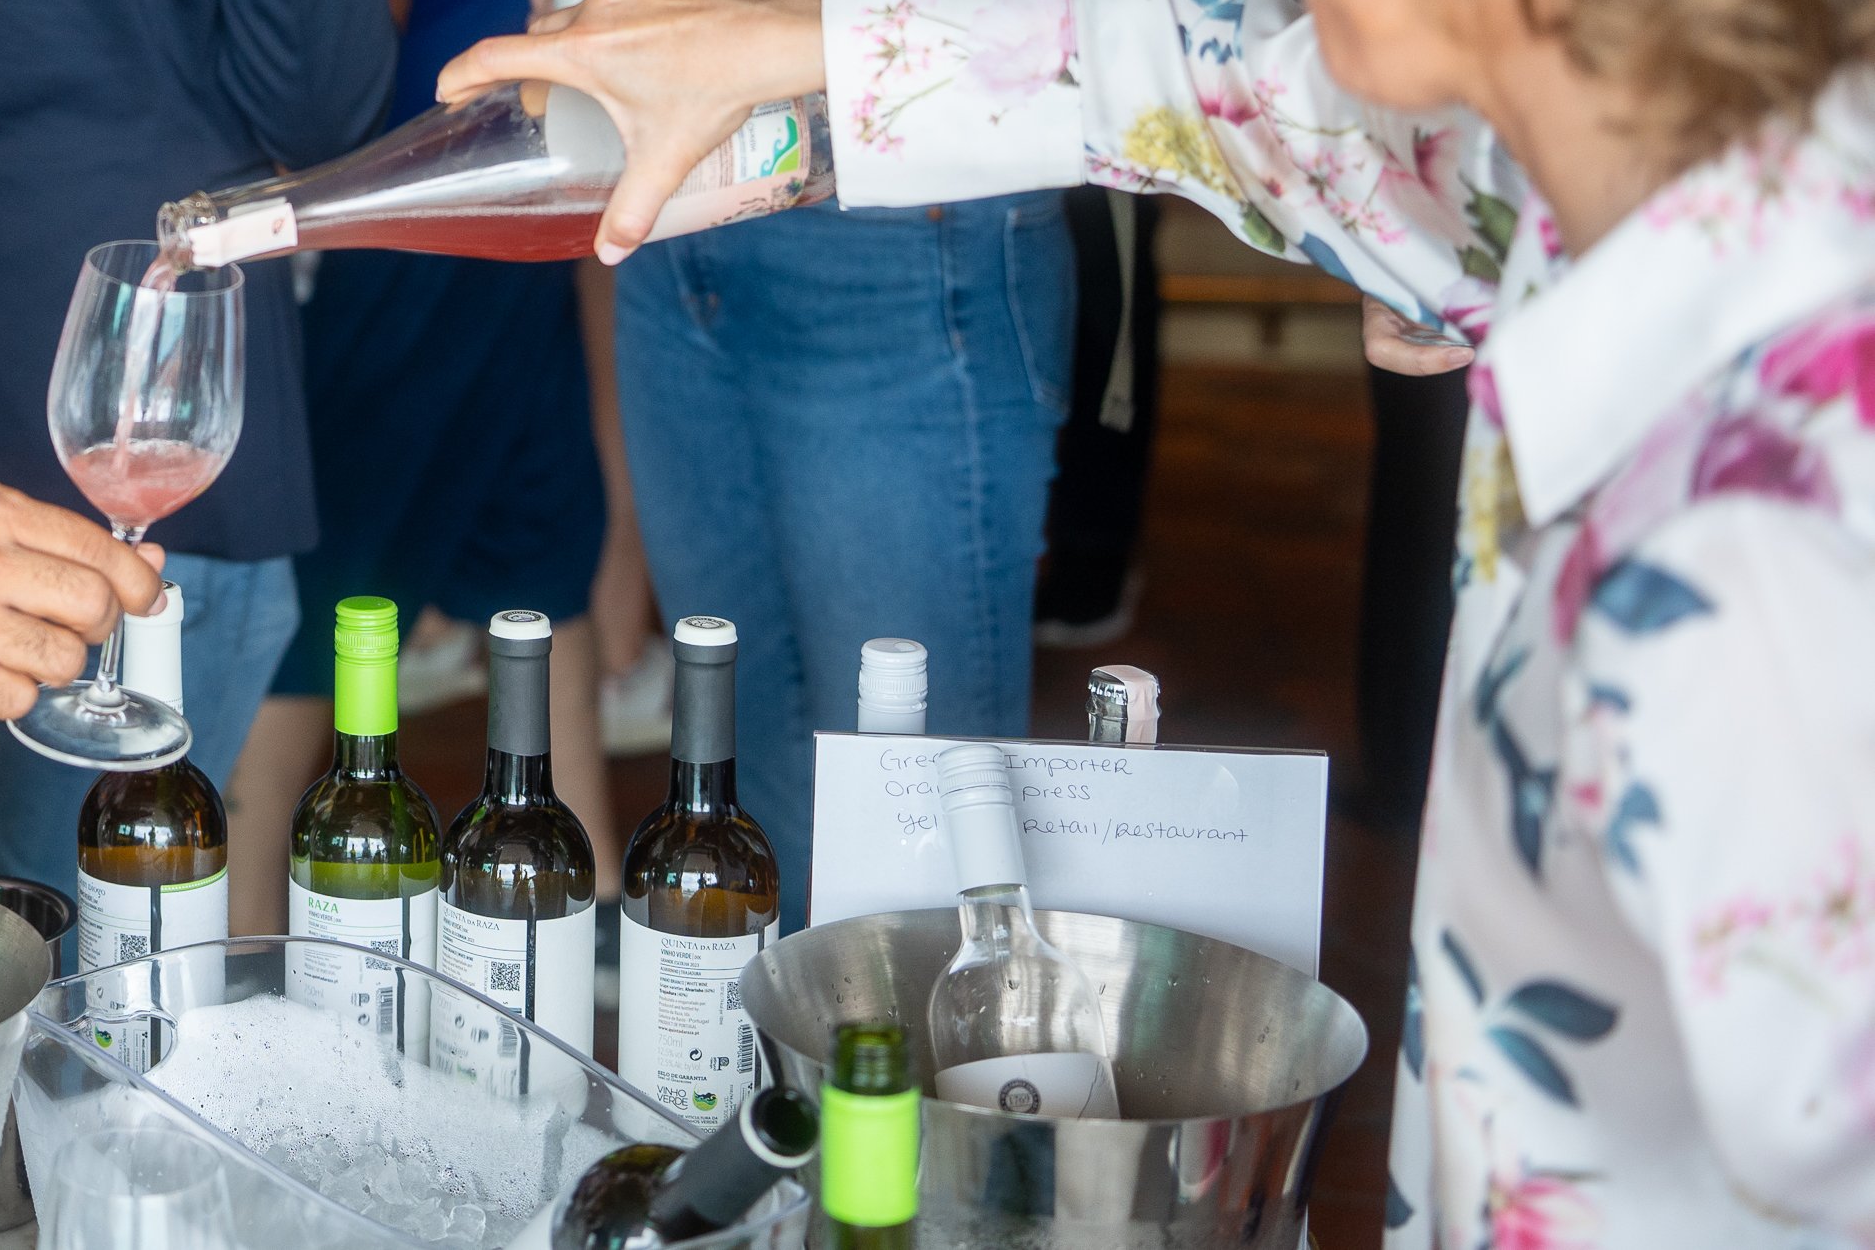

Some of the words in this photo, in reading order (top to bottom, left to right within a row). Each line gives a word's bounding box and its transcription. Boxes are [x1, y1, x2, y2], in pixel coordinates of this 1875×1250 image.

[880, 748, 939, 771] Gre
[885, 780, 941, 797] Ora
[308, 897, 339, 914] RAZA
[320, 913, 333, 922] VERDE
[443, 906, 466, 924] QUINTA
[476, 919, 500, 931] RAZA
[661, 937, 699, 950] QUINTA
[712, 942, 737, 951] RAZA
[660, 949, 676, 958] VINHO
[676, 951, 692, 960] VERDE
[659, 1034, 683, 1047] 750ml
[657, 1085, 687, 1098] VINHO
[657, 1092, 688, 1110] VERDE
